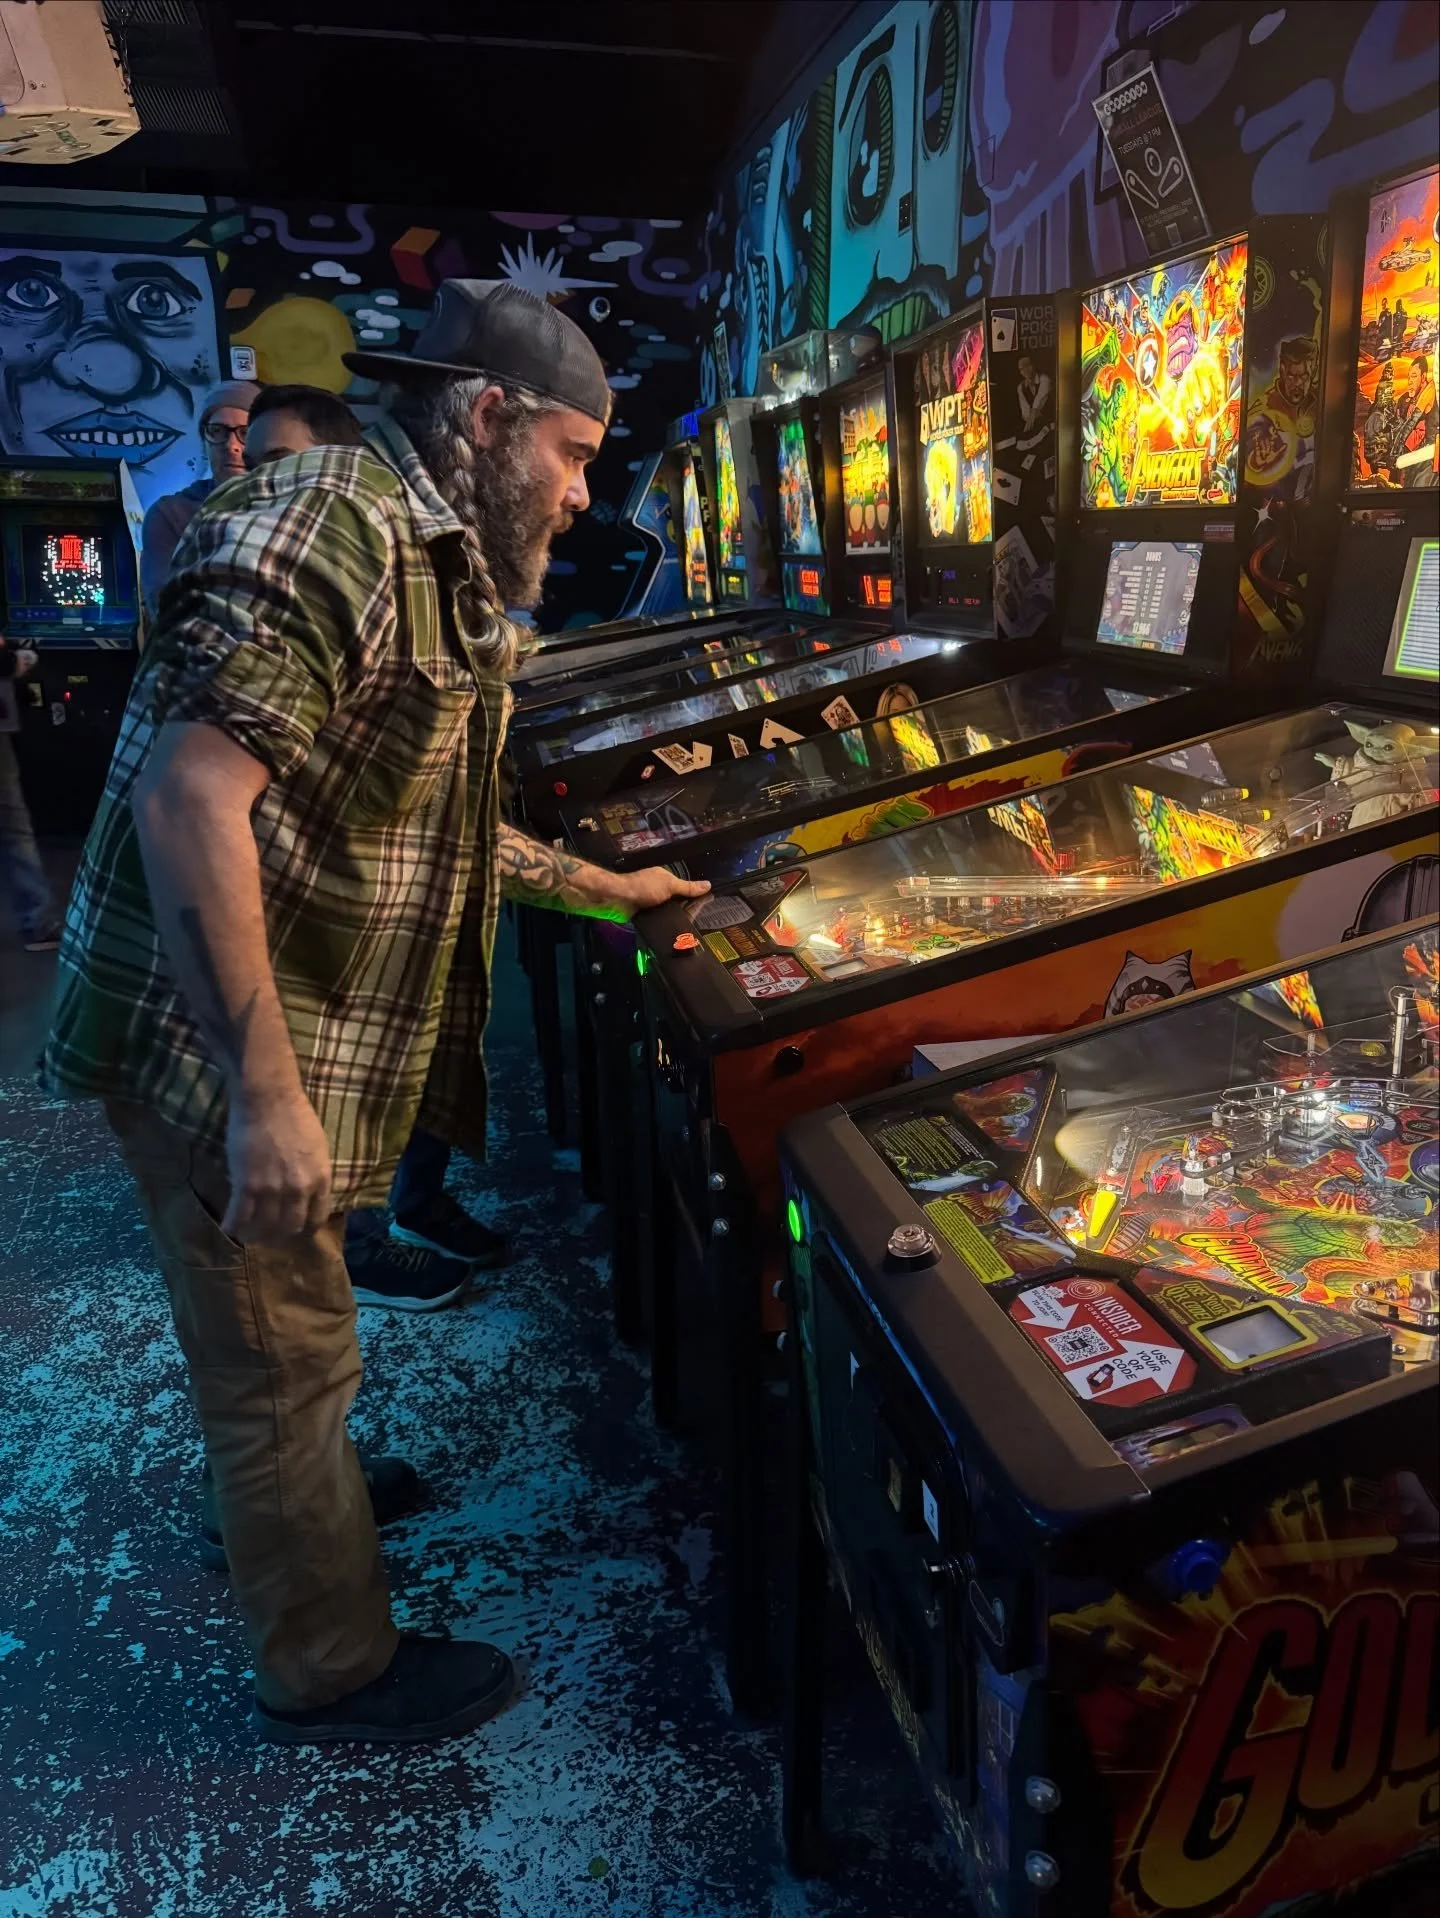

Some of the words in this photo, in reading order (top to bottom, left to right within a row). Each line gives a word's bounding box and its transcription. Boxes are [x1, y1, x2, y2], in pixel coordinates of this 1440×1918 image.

[928, 391, 964, 430] WPT
[1125, 438, 1207, 504] AVENGERS
[1176, 1232, 1299, 1298] GODZILLA
[1167, 1286, 1188, 1304] QR
[1084, 1303, 1119, 1338] CONNECTED
[1093, 1296, 1142, 1335] INSIDER
[1112, 1358, 1137, 1380] CODE
[1128, 1358, 1144, 1371] QR
[1136, 1350, 1161, 1372] YOUR
[1150, 1349, 1172, 1366] USE
